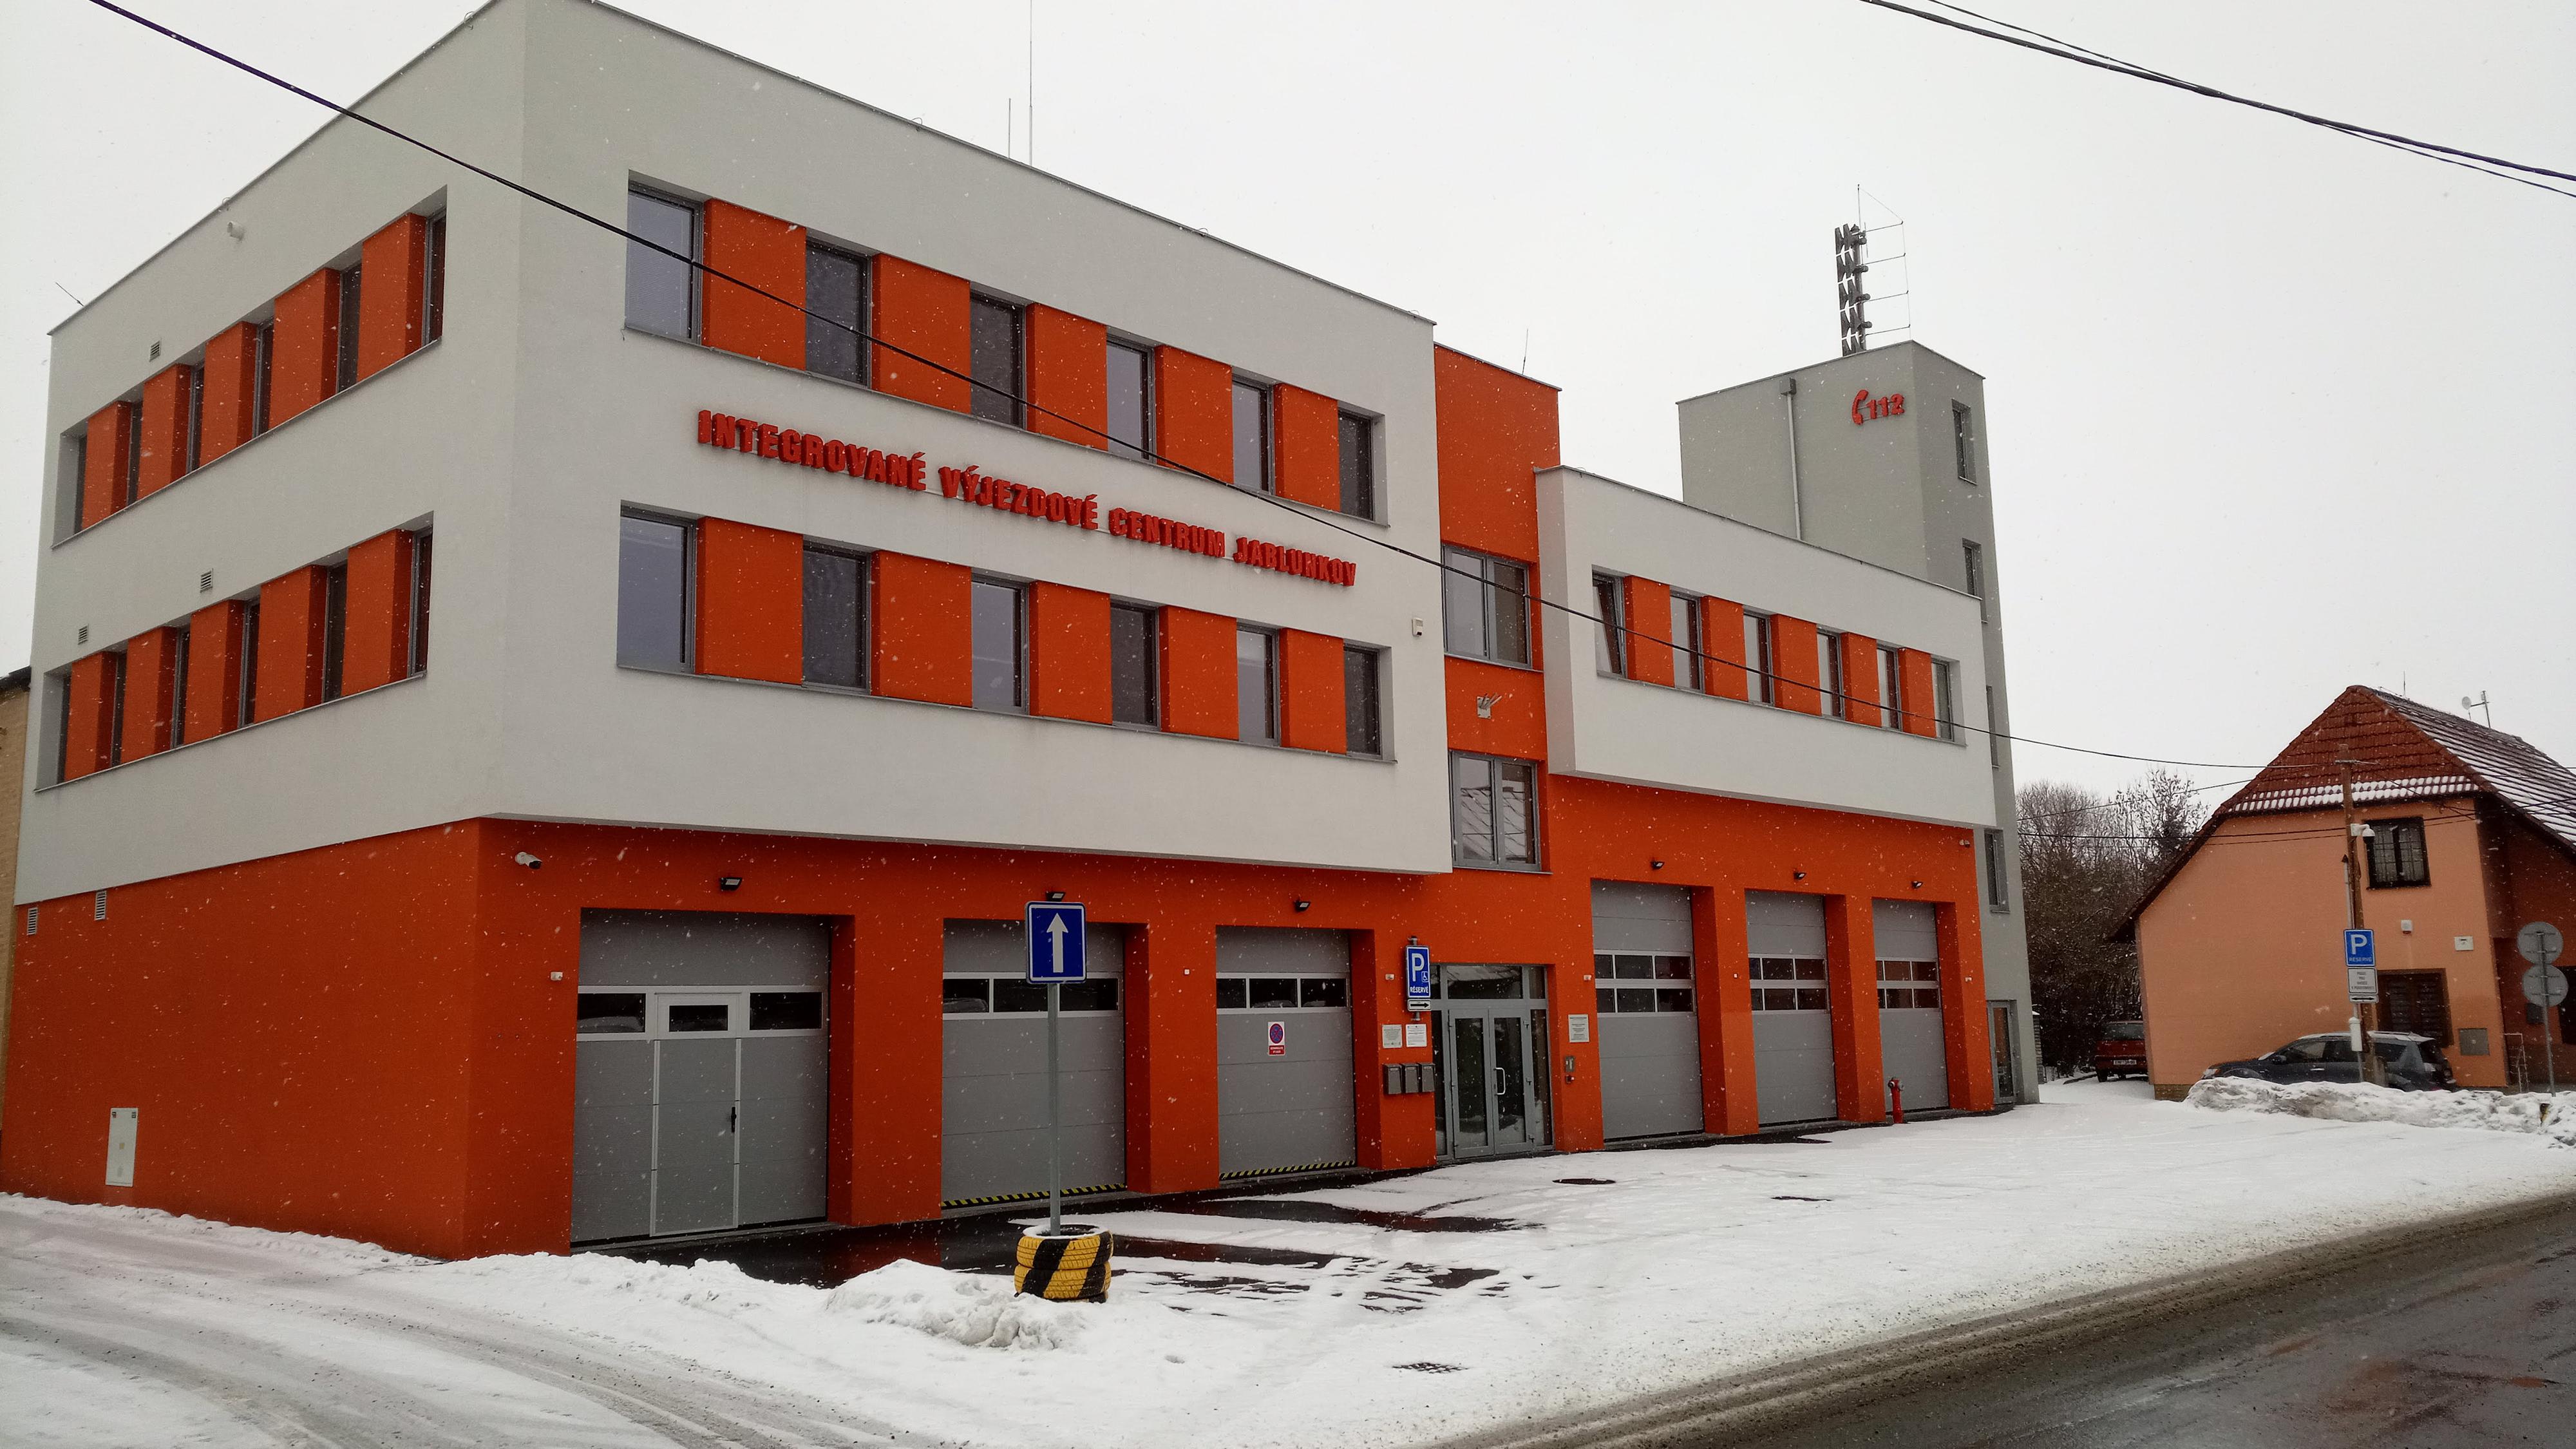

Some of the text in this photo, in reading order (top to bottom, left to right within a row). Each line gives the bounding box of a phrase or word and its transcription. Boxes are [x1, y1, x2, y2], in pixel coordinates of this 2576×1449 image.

[1866, 393, 1904, 419] 112
[698, 410, 1356, 586] INTEGROVANÉ VÝJEZDOVÉ CENTRUM JABLUNKOV
[2351, 934, 2367, 954] P
[1412, 953, 1425, 981] P
